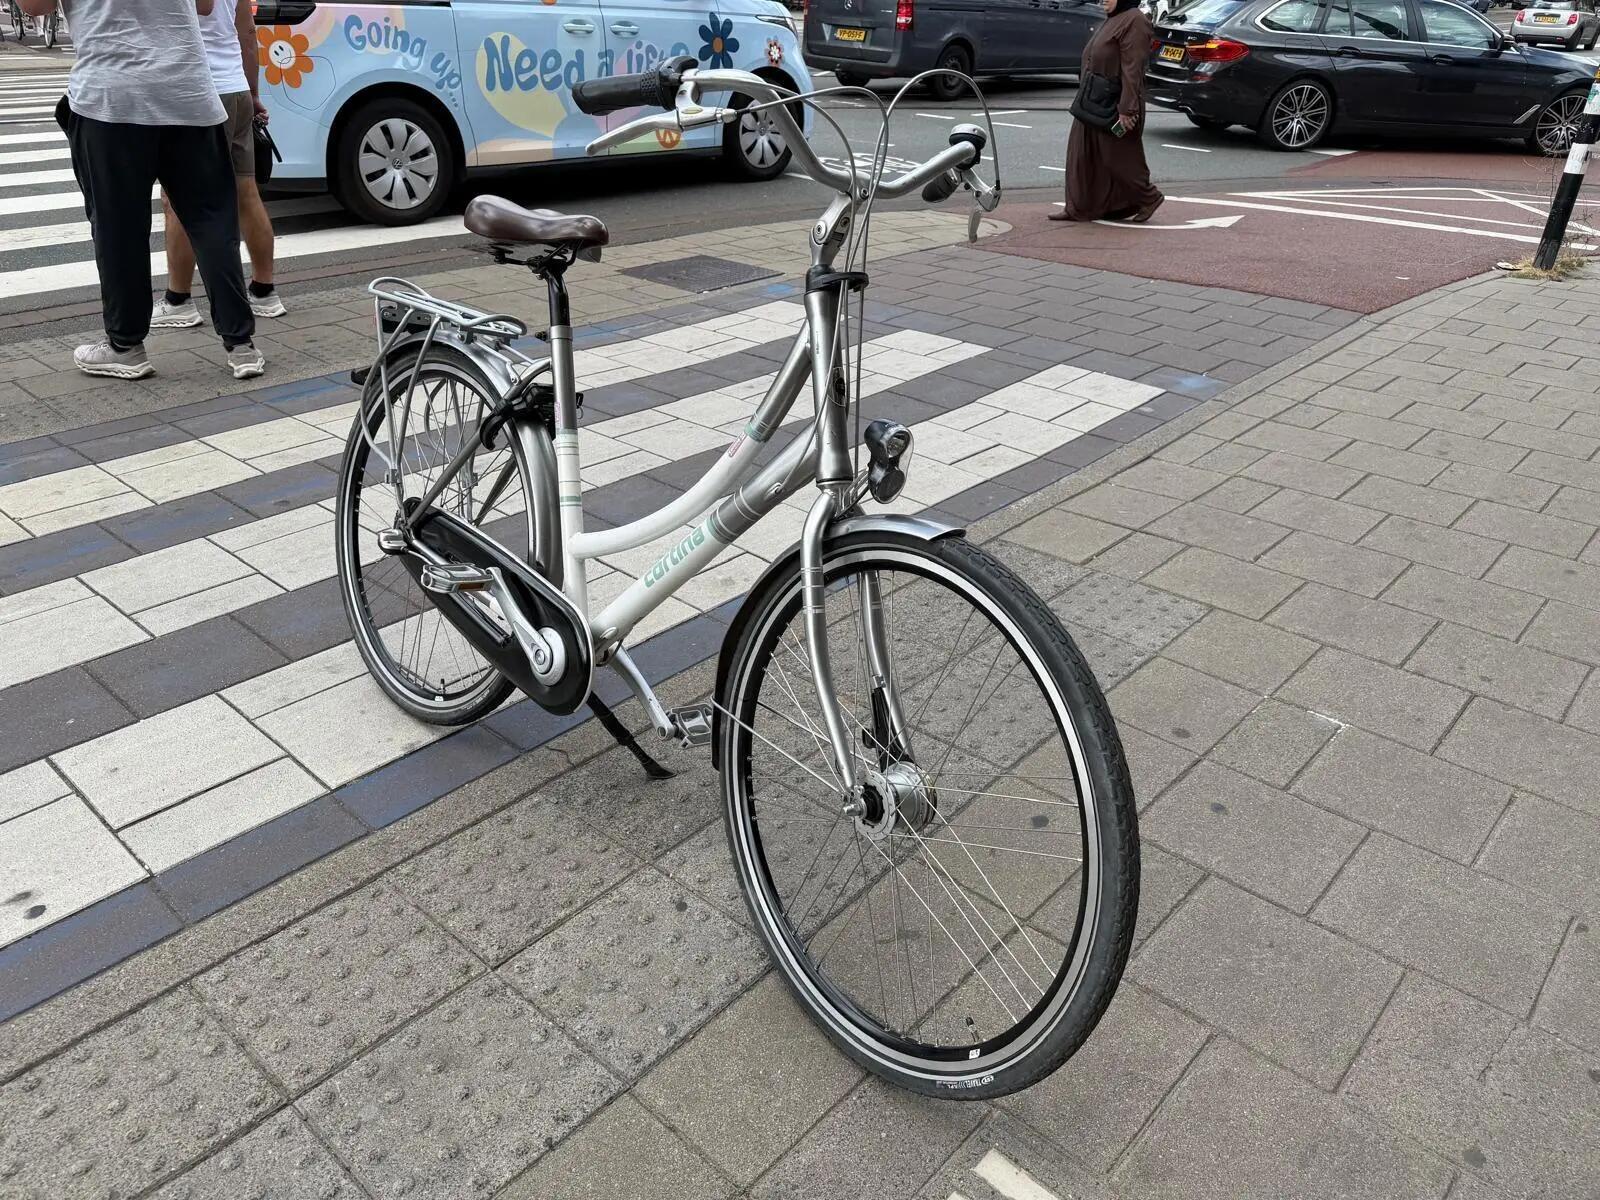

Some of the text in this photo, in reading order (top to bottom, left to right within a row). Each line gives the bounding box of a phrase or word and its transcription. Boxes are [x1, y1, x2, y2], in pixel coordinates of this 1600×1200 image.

[343, 14, 427, 71] Going
[483, 34, 585, 92] Need
[597, 48, 615, 77] a
[643, 525, 705, 588] cortina
